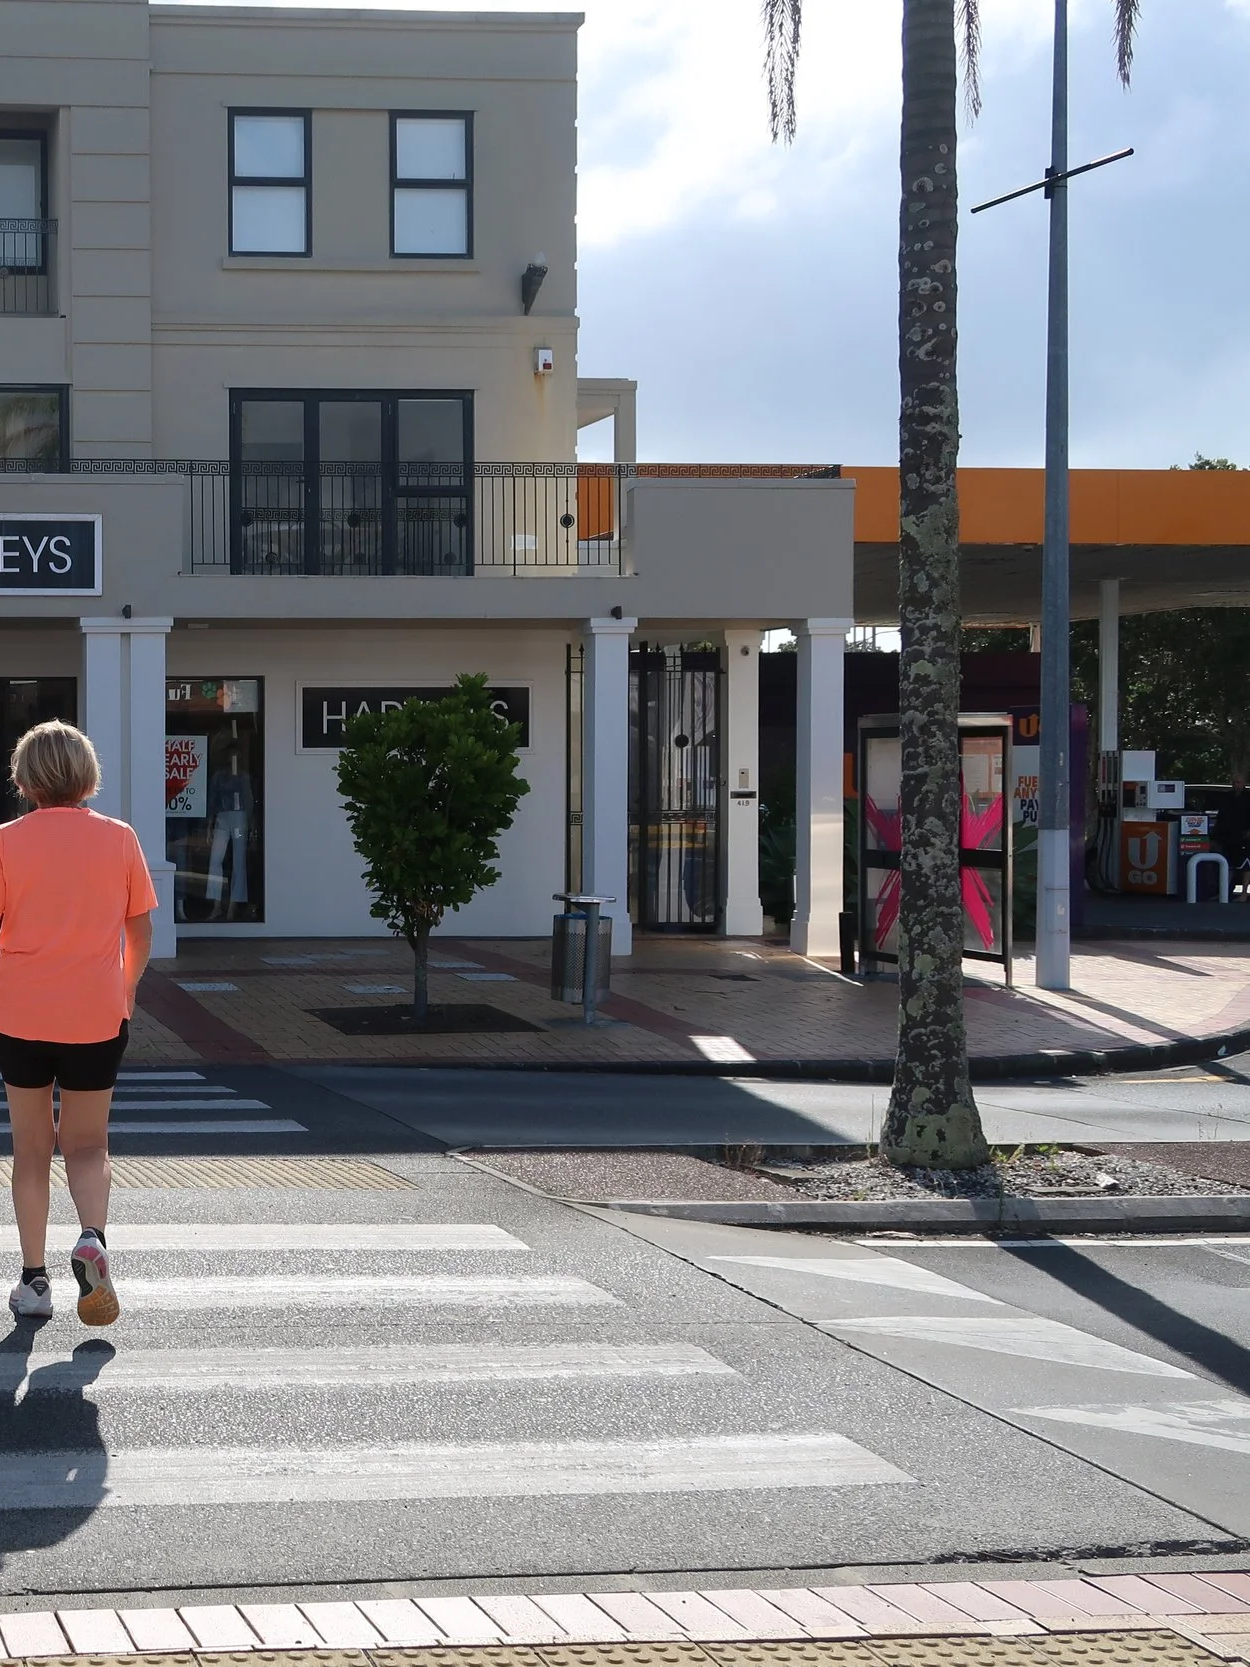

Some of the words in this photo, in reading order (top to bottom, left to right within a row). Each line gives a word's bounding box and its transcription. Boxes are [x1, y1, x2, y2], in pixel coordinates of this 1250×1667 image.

[165, 753, 202, 766] EARLY
[1017, 775, 1038, 787] FUE
[1013, 787, 1037, 799] ANY
[165, 796, 192, 811] 0%
[1022, 811, 1038, 822] PU
[1127, 870, 1158, 885] GO
